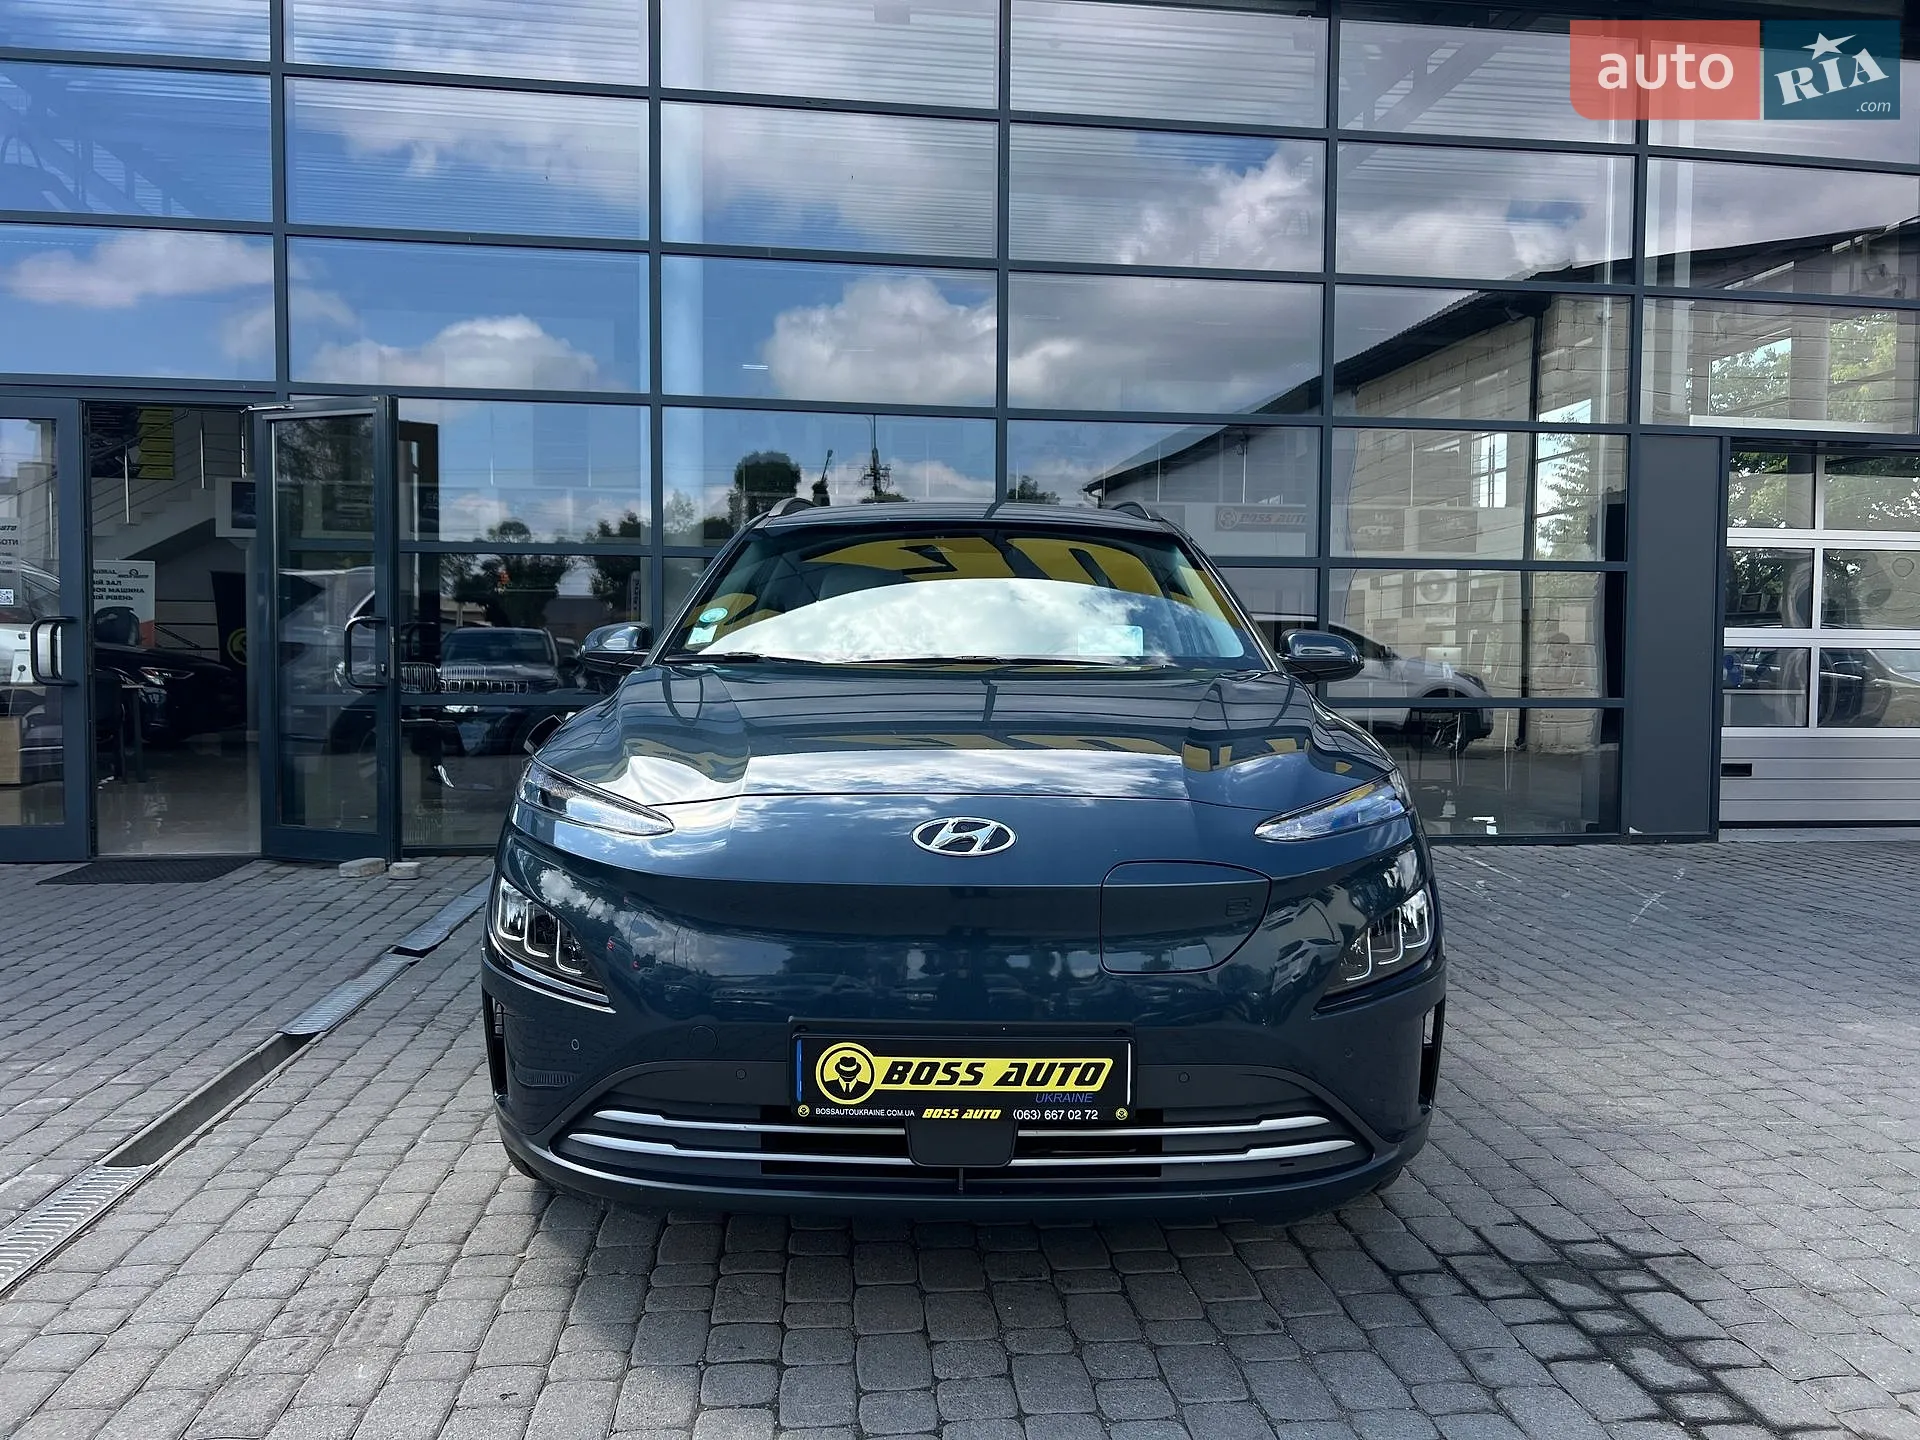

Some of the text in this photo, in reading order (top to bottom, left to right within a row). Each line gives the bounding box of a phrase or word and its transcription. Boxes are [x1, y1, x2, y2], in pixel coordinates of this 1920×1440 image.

[0, 538, 19, 546] ОТИ
[880, 1061, 1107, 1087] BOSS AUTO
[1035, 1092, 1093, 1103] UKRAINE
[815, 1107, 916, 1117] BOSSAUTOUKRAINE.COM.UA
[921, 1108, 1002, 1120] BOSS AUTO
[1012, 1109, 1098, 1122] (063) 667 02 72
